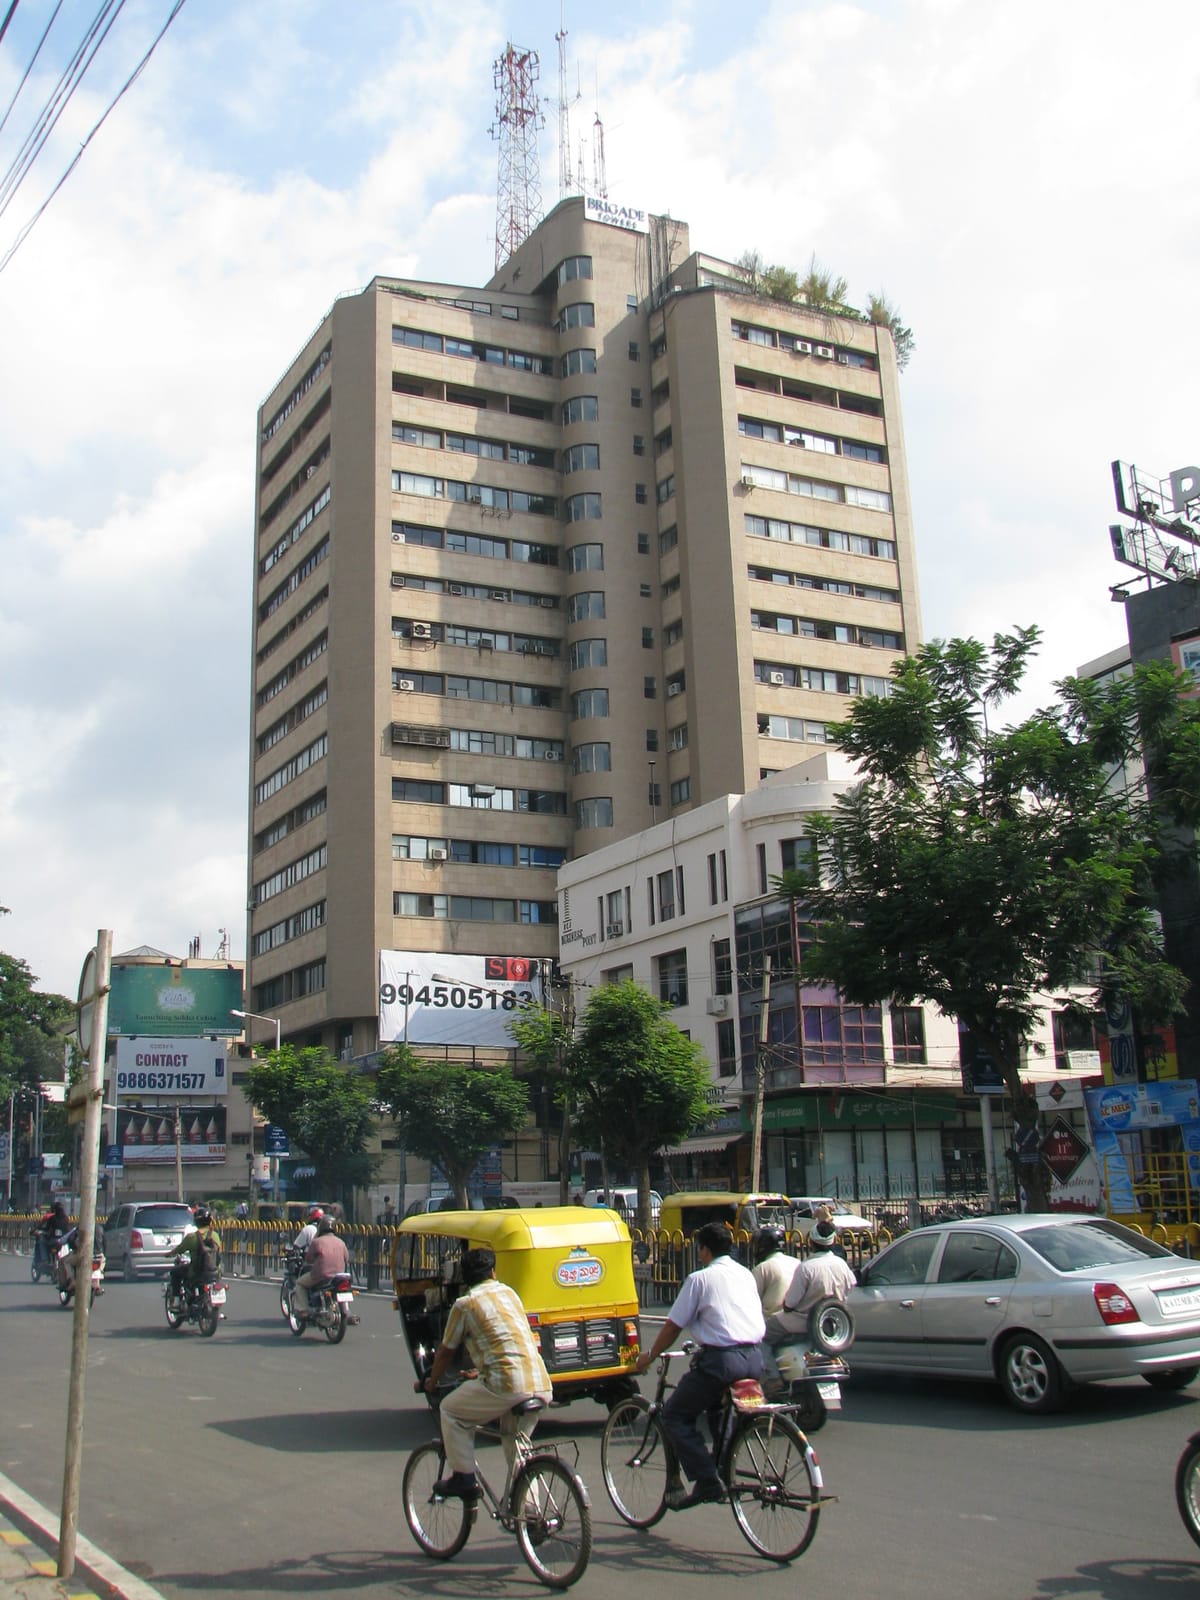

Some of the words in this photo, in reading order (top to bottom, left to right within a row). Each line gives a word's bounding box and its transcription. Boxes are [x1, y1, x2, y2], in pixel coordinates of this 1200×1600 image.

[587, 197, 645, 222] BRIGADE
[597, 212, 638, 229] TOWERS
[135, 1053, 189, 1067] CONTACT
[117, 1072, 206, 1089] 9886371577
